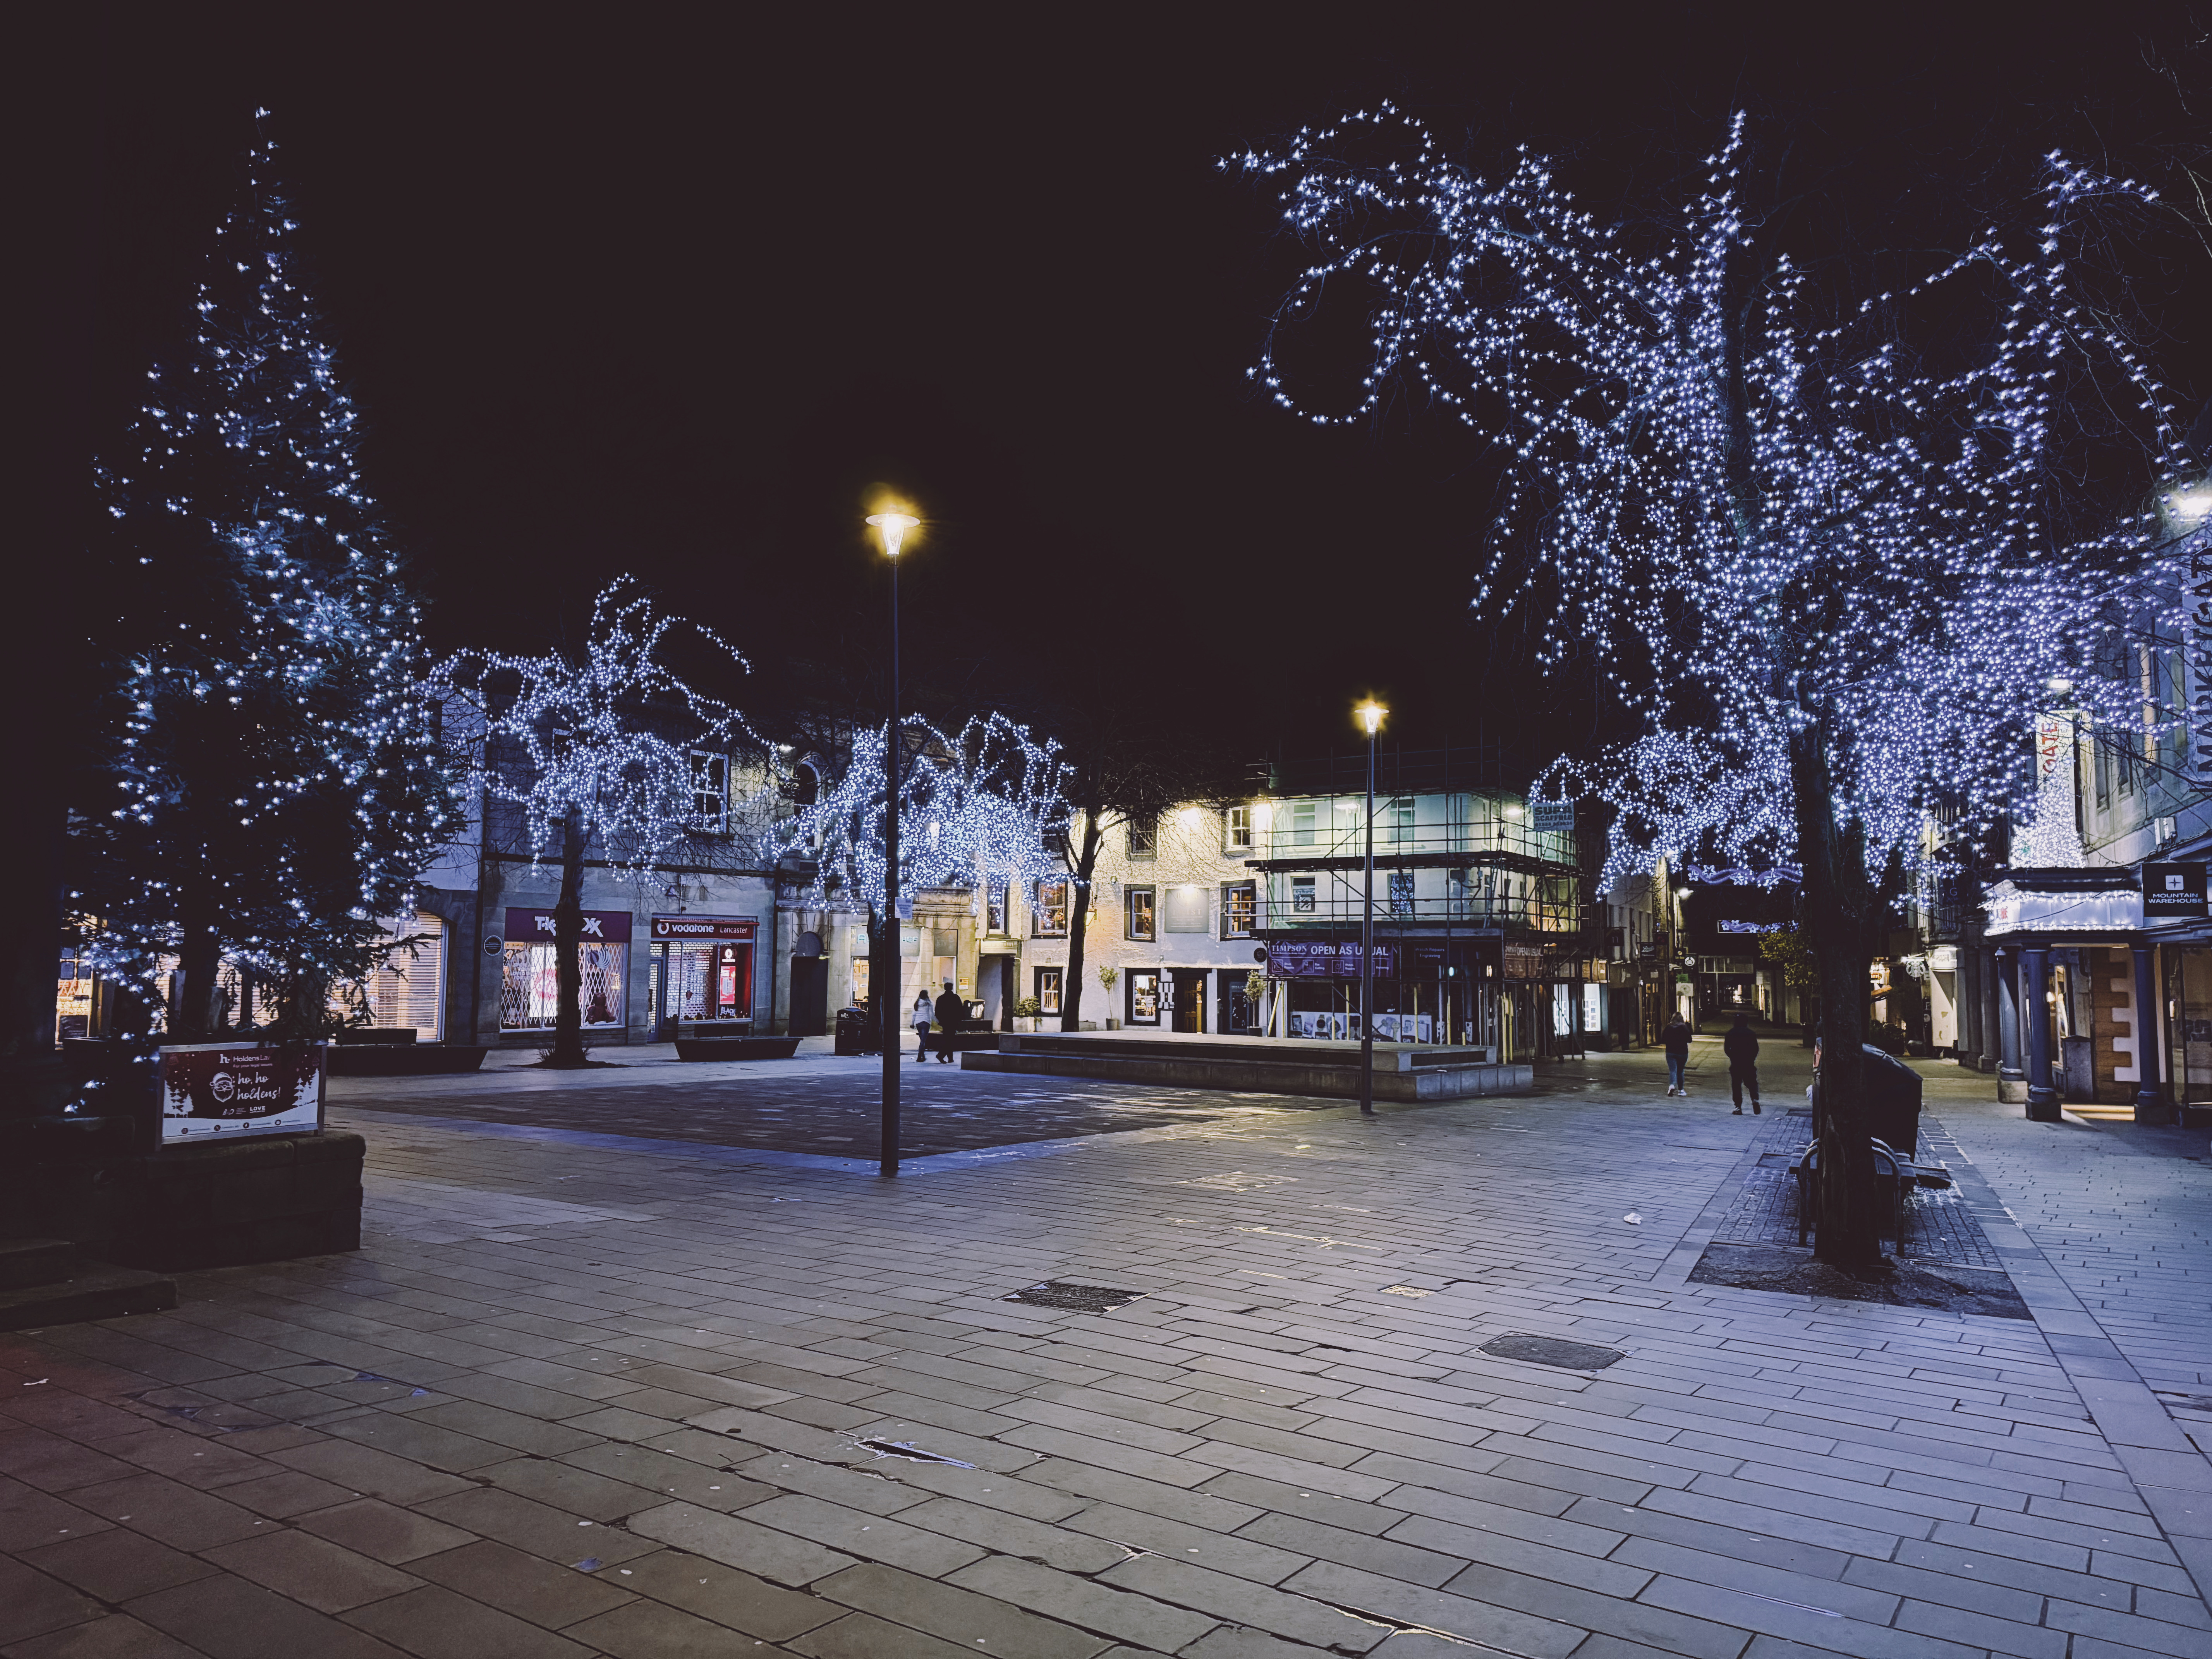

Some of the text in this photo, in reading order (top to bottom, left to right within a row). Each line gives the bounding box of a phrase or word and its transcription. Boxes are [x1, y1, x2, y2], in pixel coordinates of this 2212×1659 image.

[1535, 806, 1572, 815] SUPA
[672, 924, 714, 933] vodafone
[1311, 946, 1336, 955] OPEN
[1339, 946, 1352, 955] AS
[1355, 946, 1389, 956] UUAL
[255, 1072, 270, 1083] ho
[237, 1086, 281, 1100] holdens!
